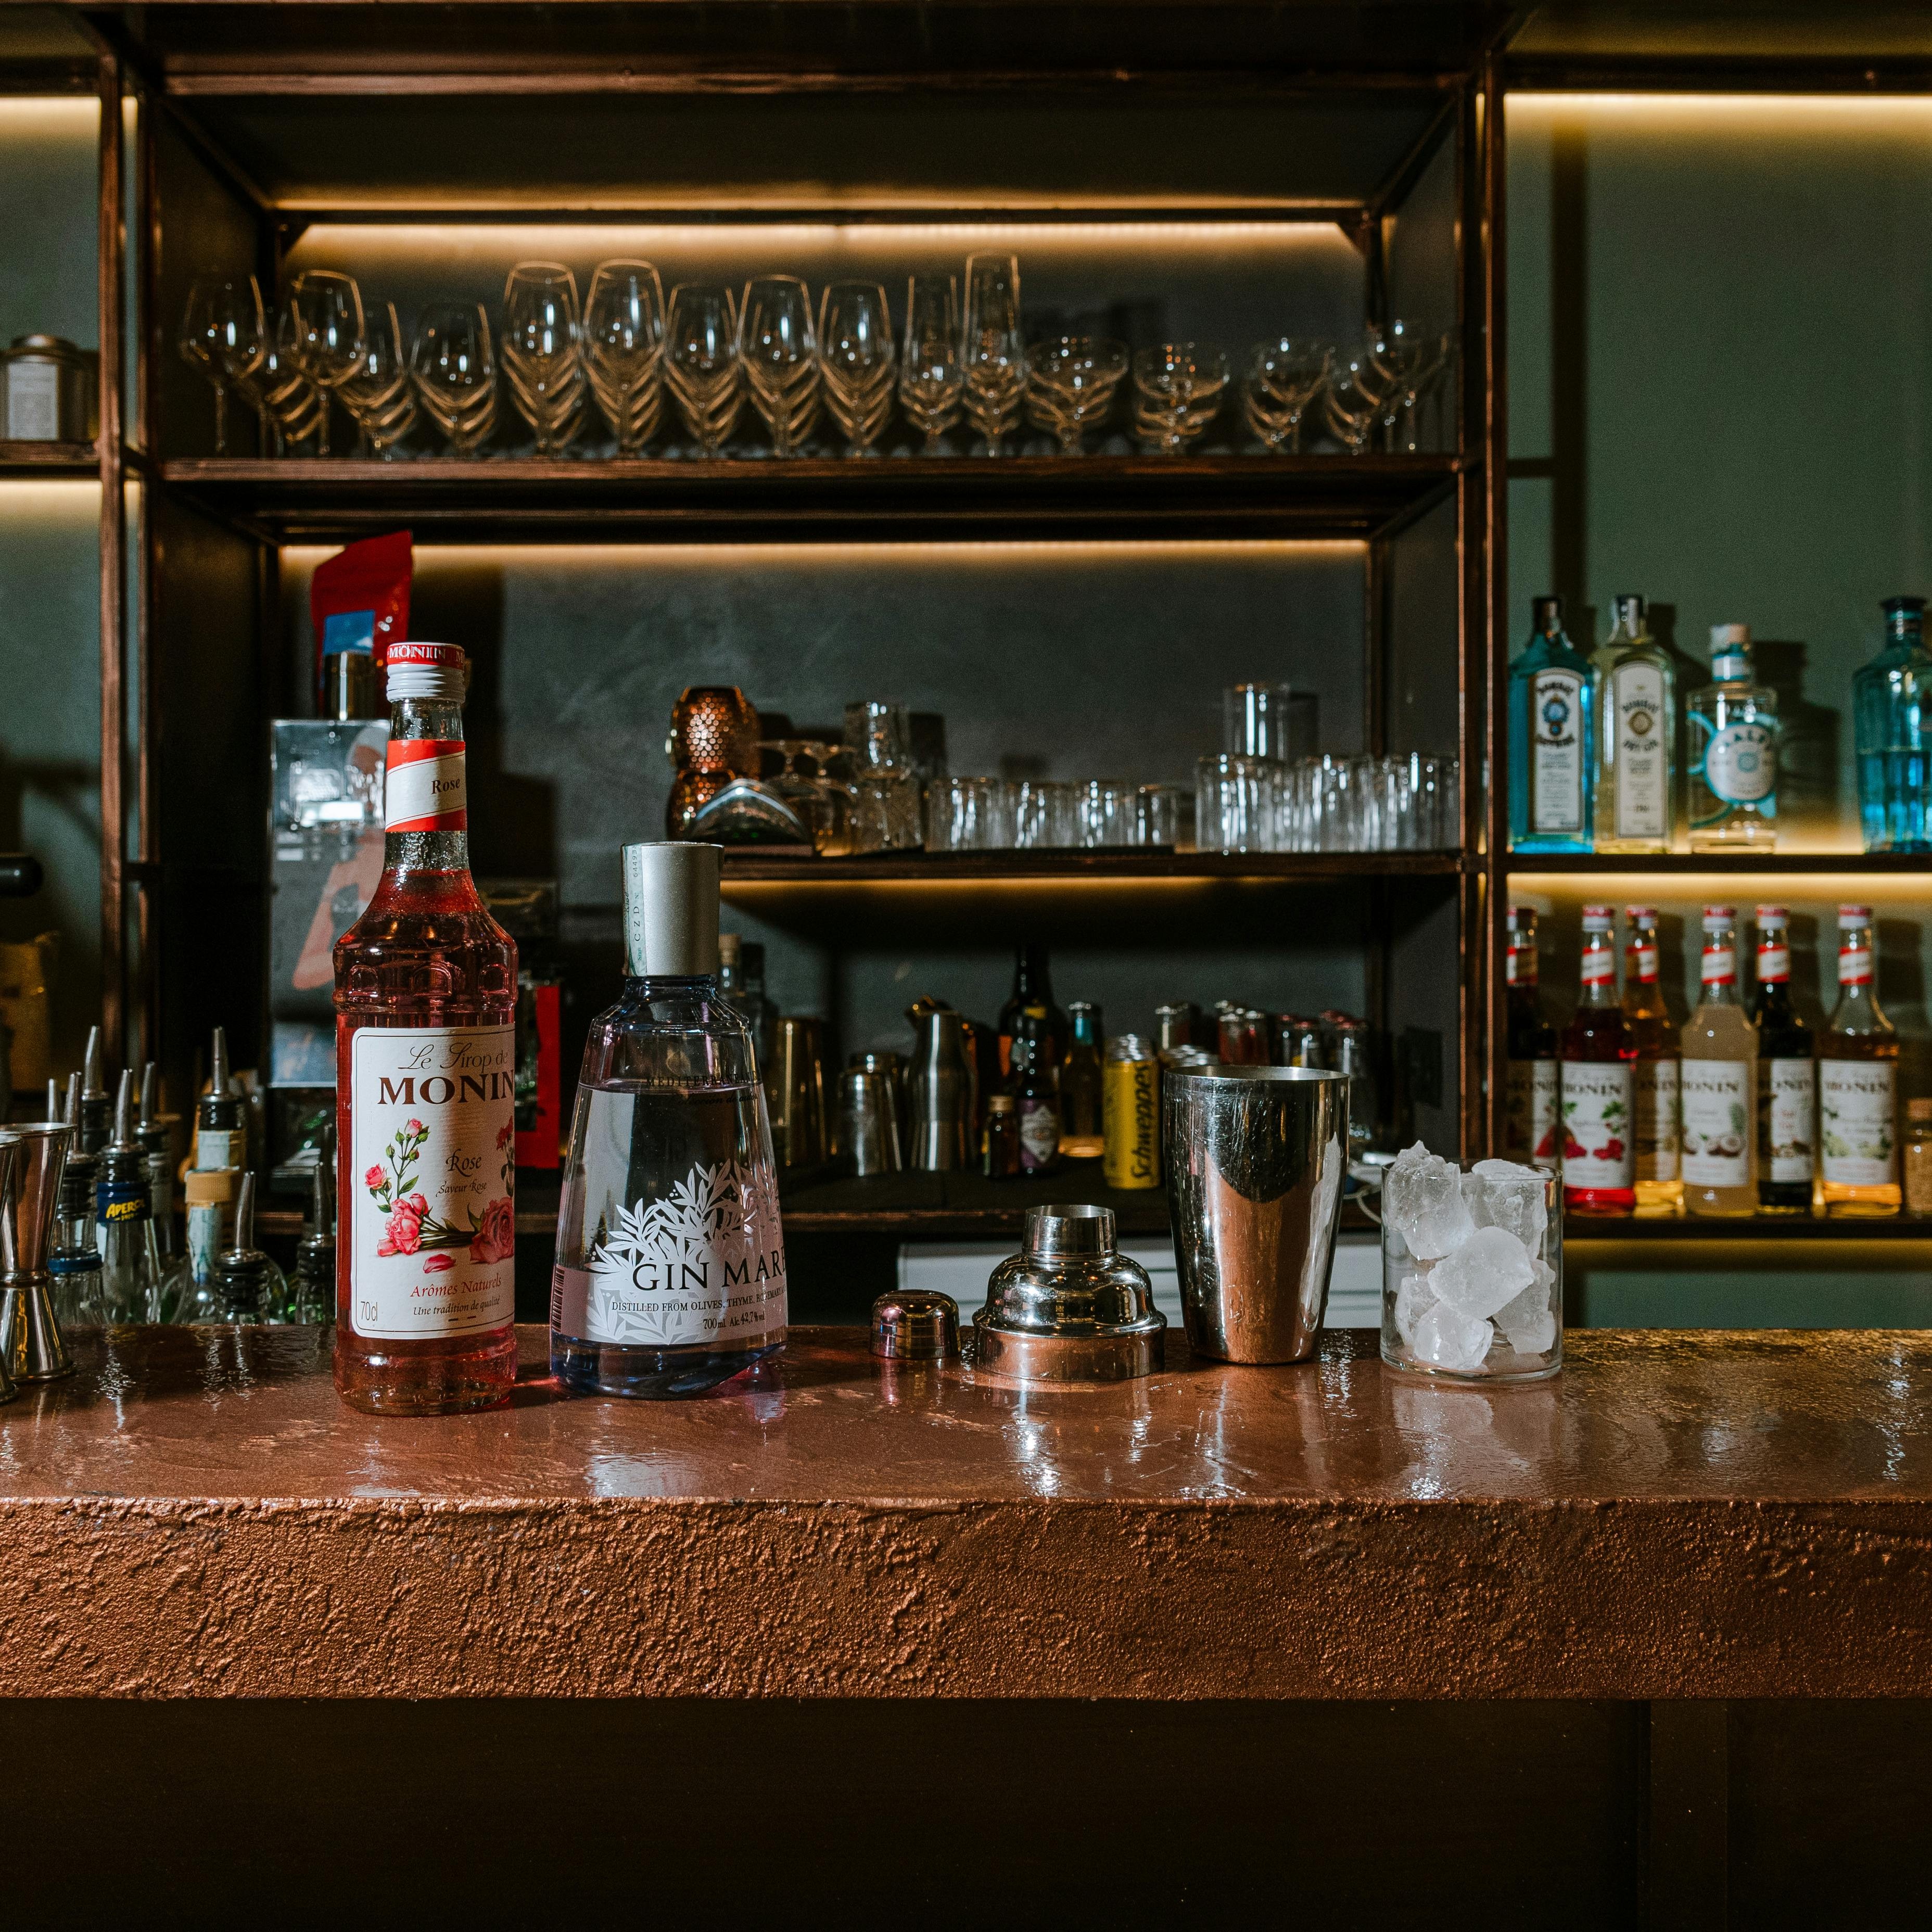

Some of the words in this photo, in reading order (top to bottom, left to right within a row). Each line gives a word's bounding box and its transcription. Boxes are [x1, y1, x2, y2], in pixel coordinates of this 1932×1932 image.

[431, 778, 461, 795] Rose
[398, 1044, 434, 1070] Le
[440, 1042, 492, 1074] Sirop
[495, 1050, 508, 1065] de
[377, 1069, 514, 1105] MONIN
[446, 1149, 482, 1177] Rose
[436, 1180, 467, 1198] Saveur
[469, 1179, 487, 1194] Rose
[410, 1283, 458, 1298] Arômes
[460, 1273, 501, 1294] Naturels
[632, 1262, 710, 1291] GIN
[360, 1301, 378, 1322] 70cl
[413, 1306, 431, 1316] Une
[433, 1303, 468, 1314] tradition
[470, 1300, 479, 1310] de
[479, 1297, 500, 1313] qualité
[612, 1302, 659, 1312] DISTILLED
[662, 1302, 688, 1312] FROM
[691, 1300, 725, 1311] OLIVES,
[727, 1295, 755, 1307] THYME,
